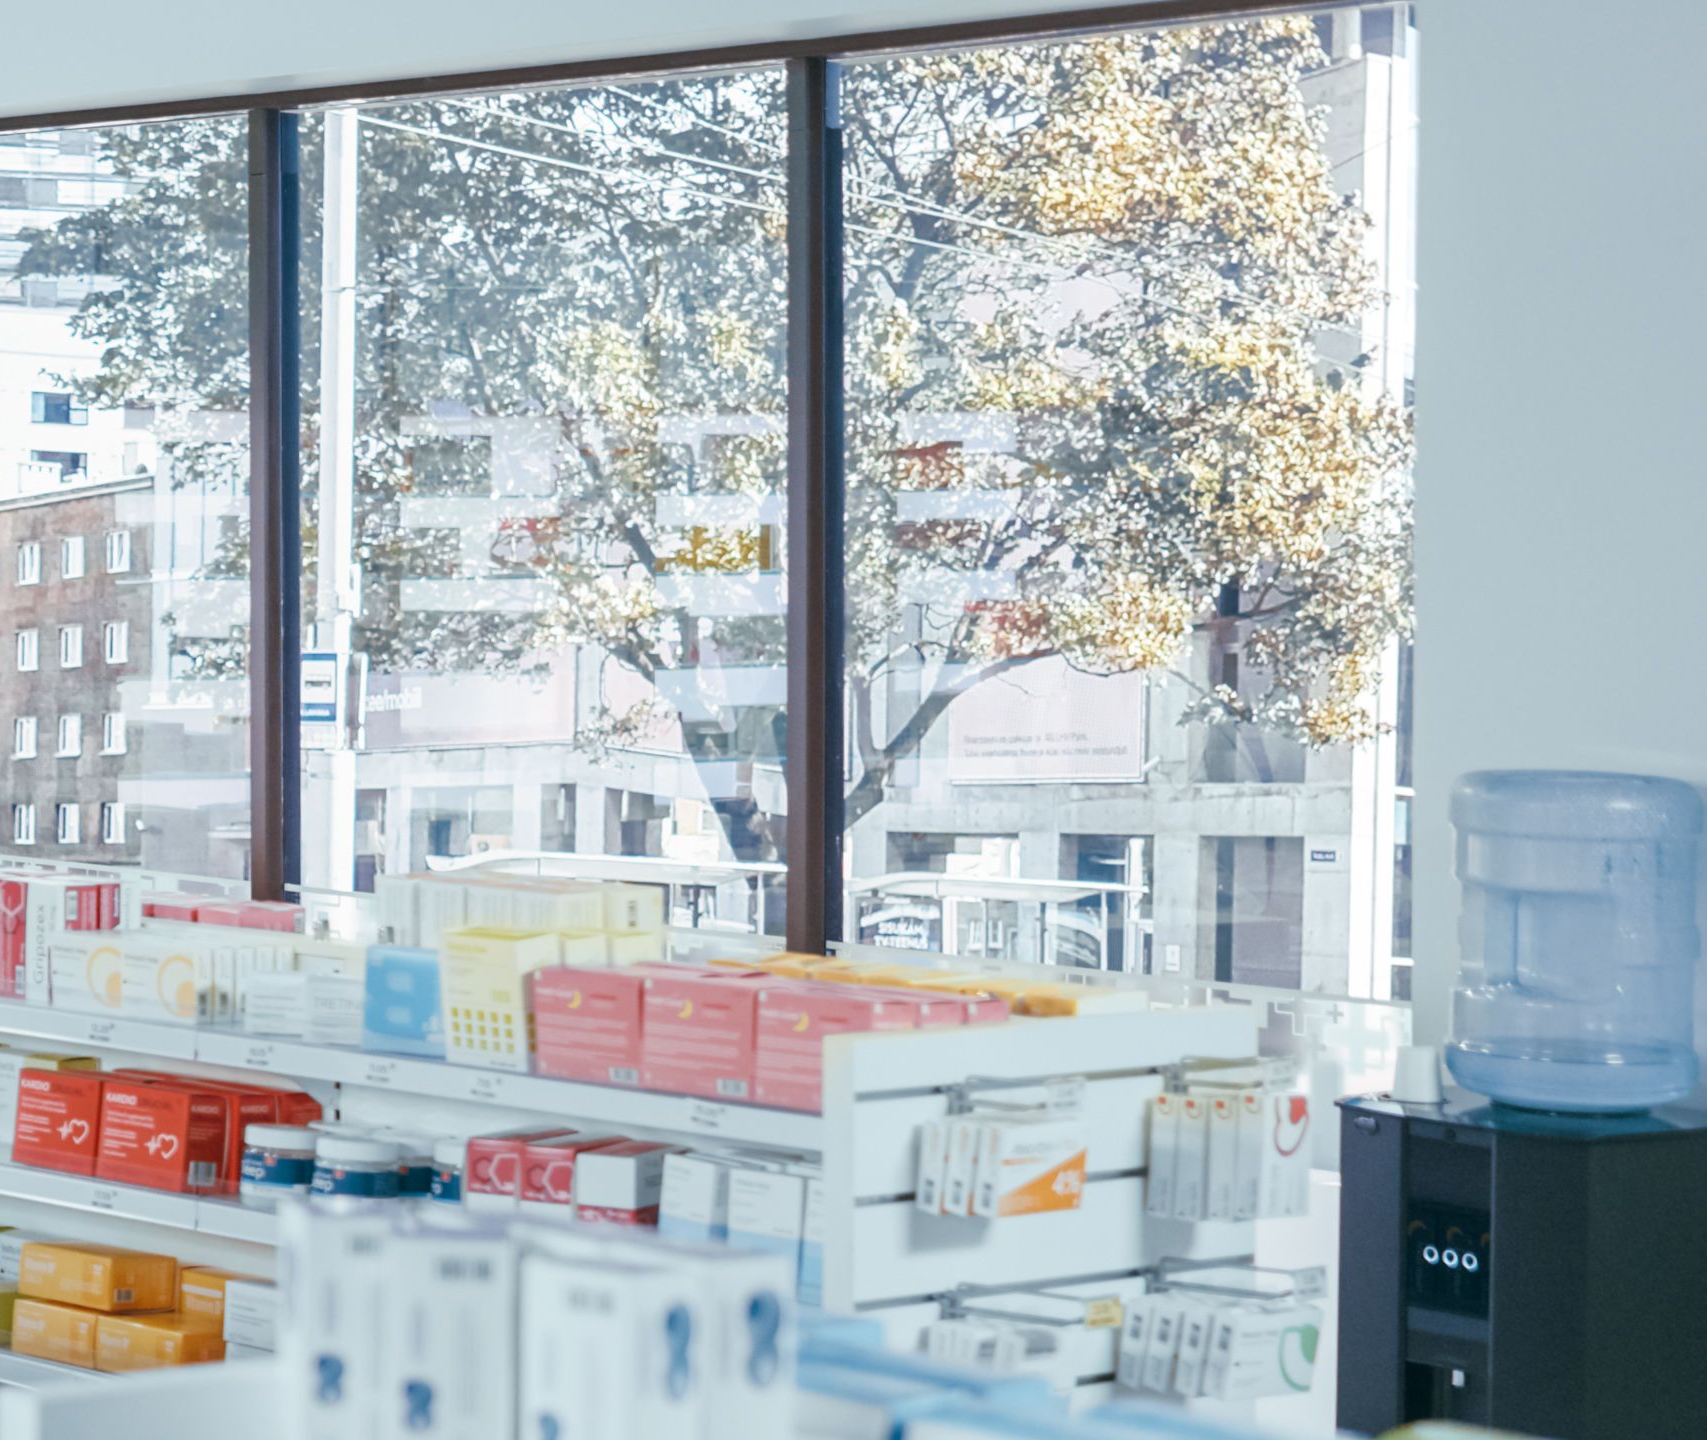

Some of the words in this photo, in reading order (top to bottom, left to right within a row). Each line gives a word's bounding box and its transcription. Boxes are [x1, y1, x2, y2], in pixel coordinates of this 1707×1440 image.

[33, 903, 44, 985] Gripozex
[20, 1078, 51, 1092] KARDIO
[106, 1092, 136, 1106] KARDIO
